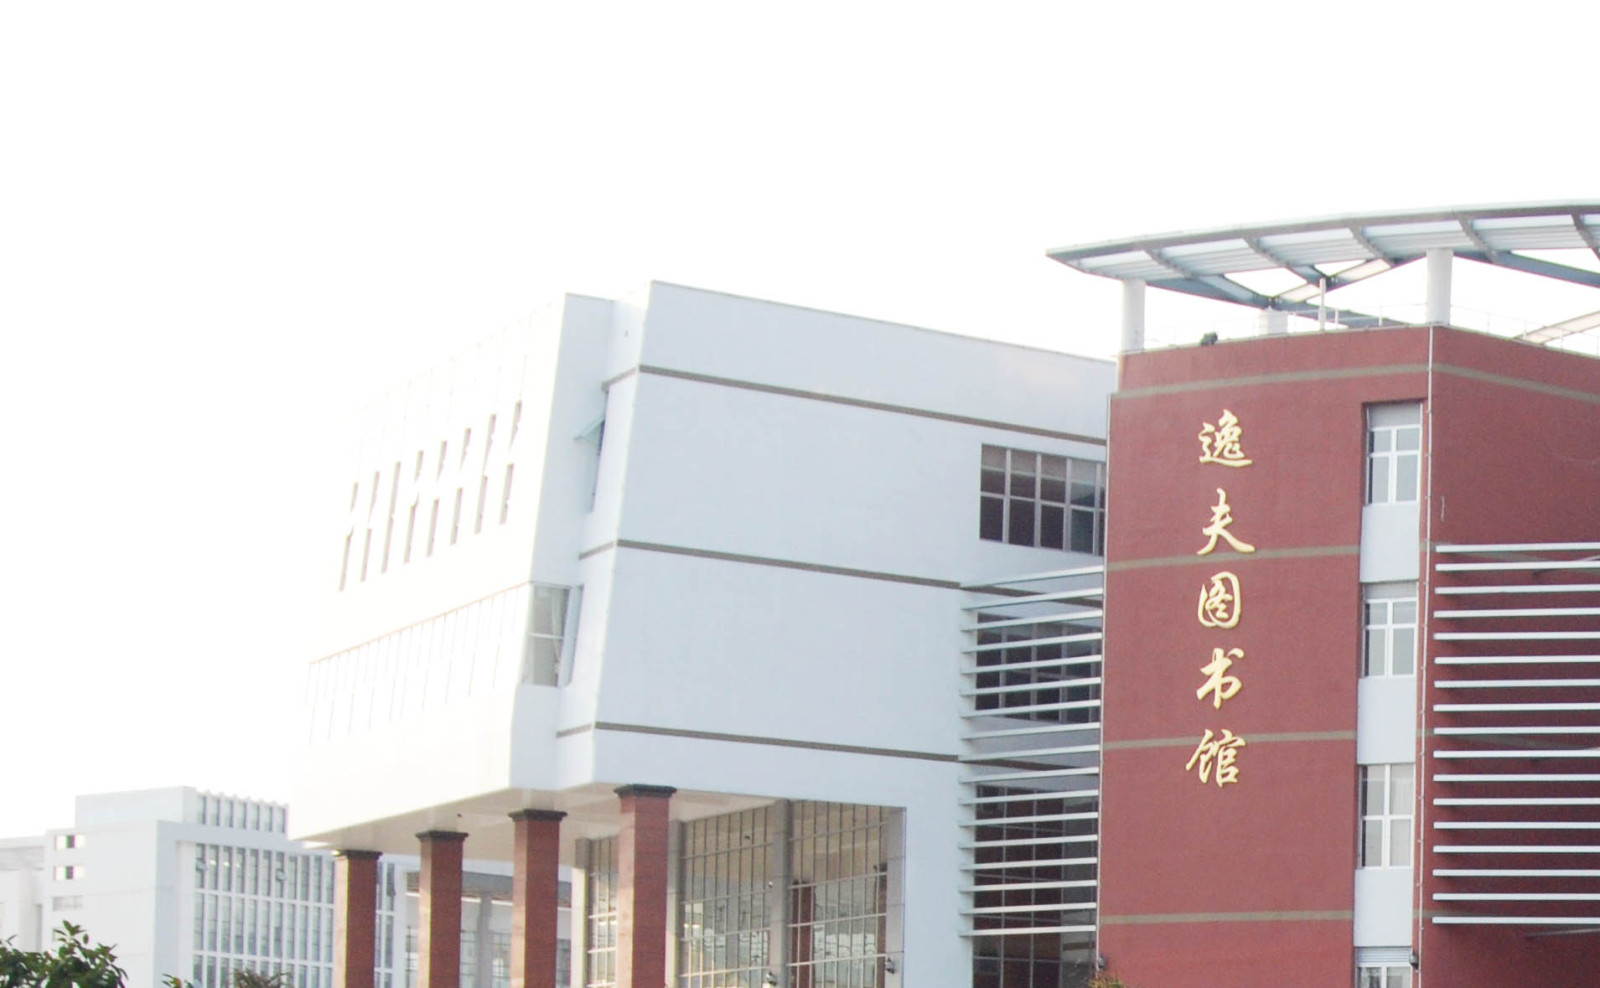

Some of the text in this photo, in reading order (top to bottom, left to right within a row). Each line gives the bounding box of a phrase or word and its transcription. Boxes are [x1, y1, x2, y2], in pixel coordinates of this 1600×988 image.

[1185, 408, 1255, 788] 逸夫图书馆
